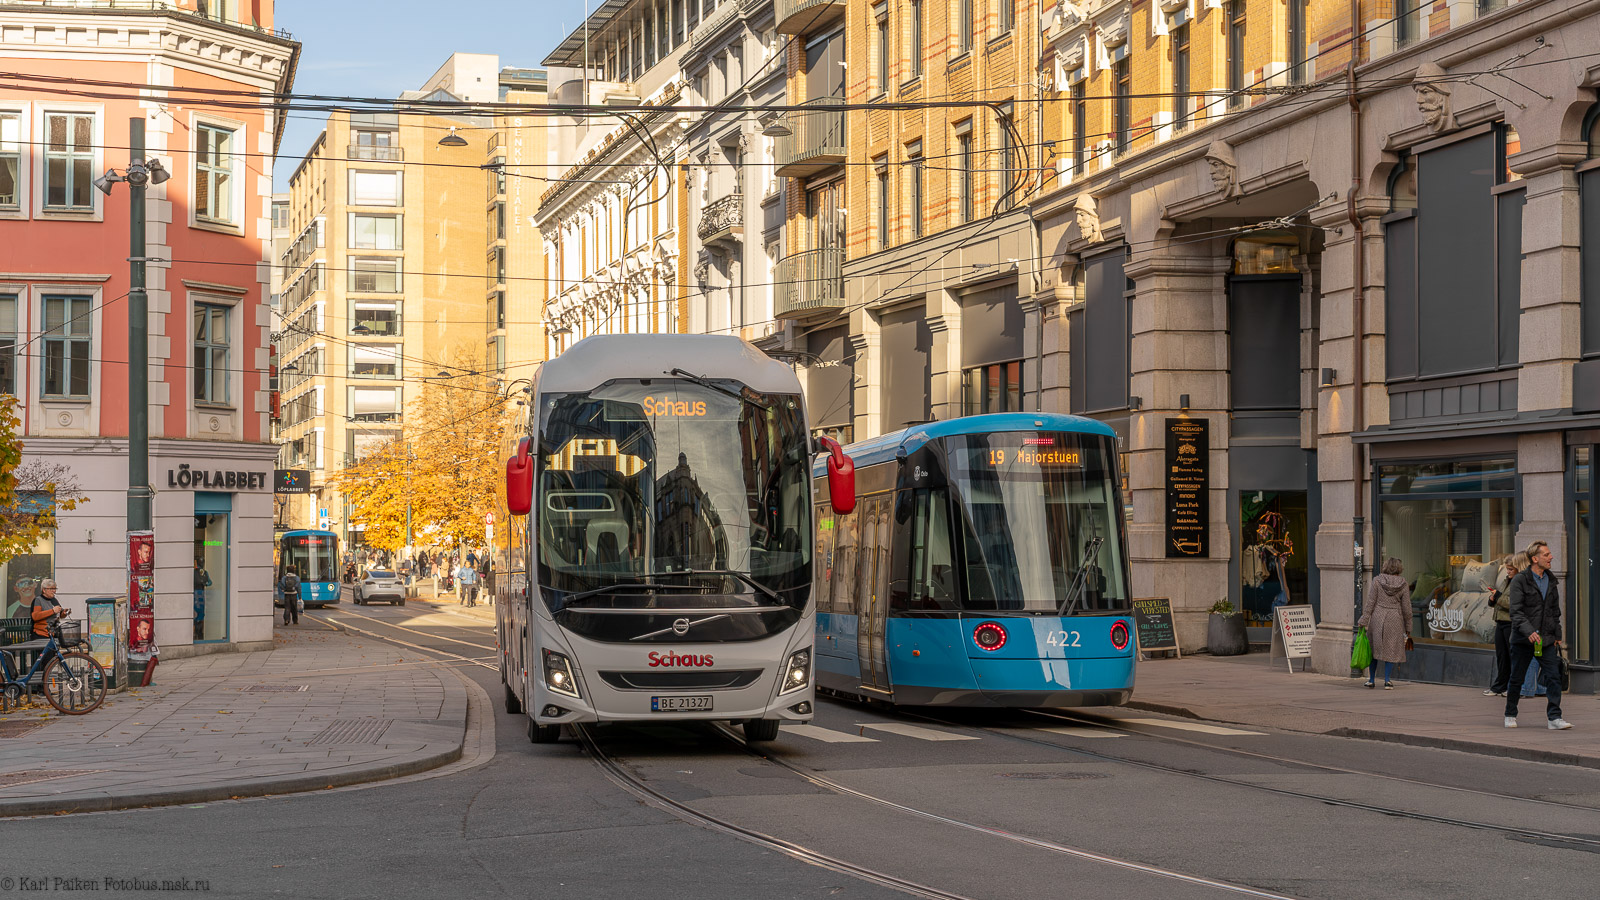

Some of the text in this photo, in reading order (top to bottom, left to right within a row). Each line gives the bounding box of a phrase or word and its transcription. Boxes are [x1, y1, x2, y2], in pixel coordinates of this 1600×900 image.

[513, 98, 523, 233] ISENKVARTALET
[643, 396, 707, 416] Schaus
[989, 449, 1079, 466] 19 Majorstuen
[167, 463, 267, 489] LÖPLABBET
[1046, 630, 1081, 647] 422
[648, 650, 714, 667] Schaus
[661, 697, 709, 708] BE 21327
